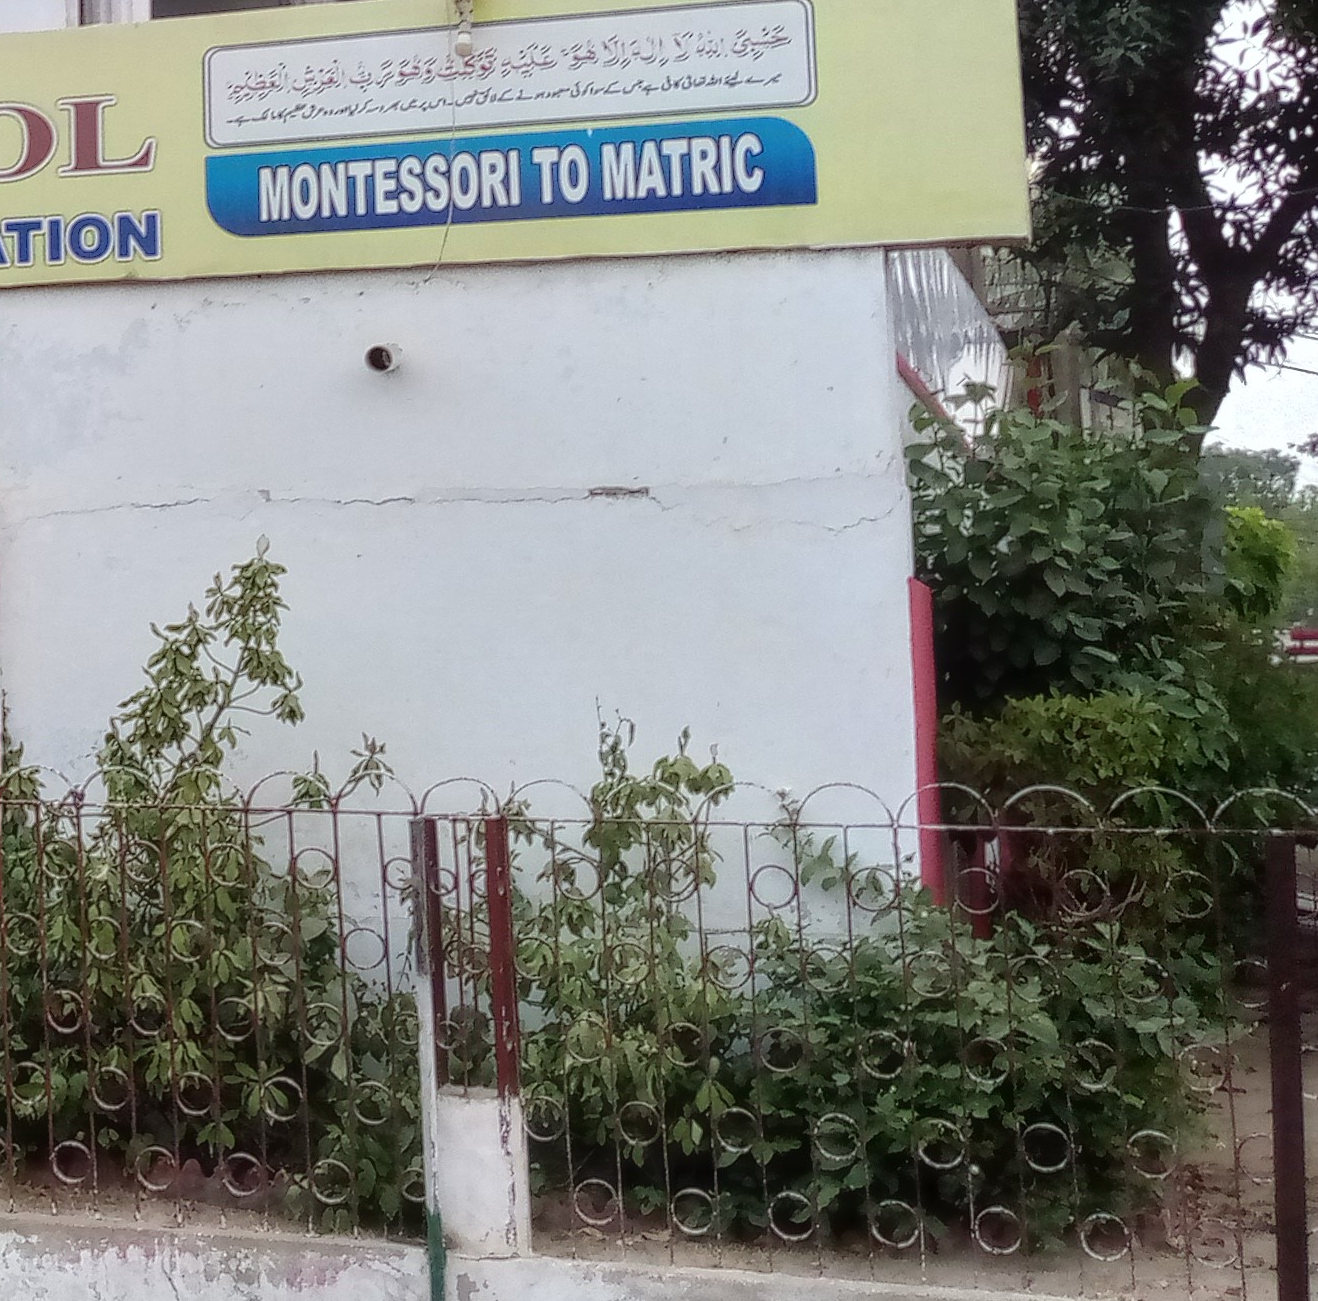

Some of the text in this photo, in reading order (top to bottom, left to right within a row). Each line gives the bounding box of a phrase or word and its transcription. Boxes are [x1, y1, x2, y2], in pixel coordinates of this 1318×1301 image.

[258, 131, 764, 223] MONTESSORI TO MATRIC
